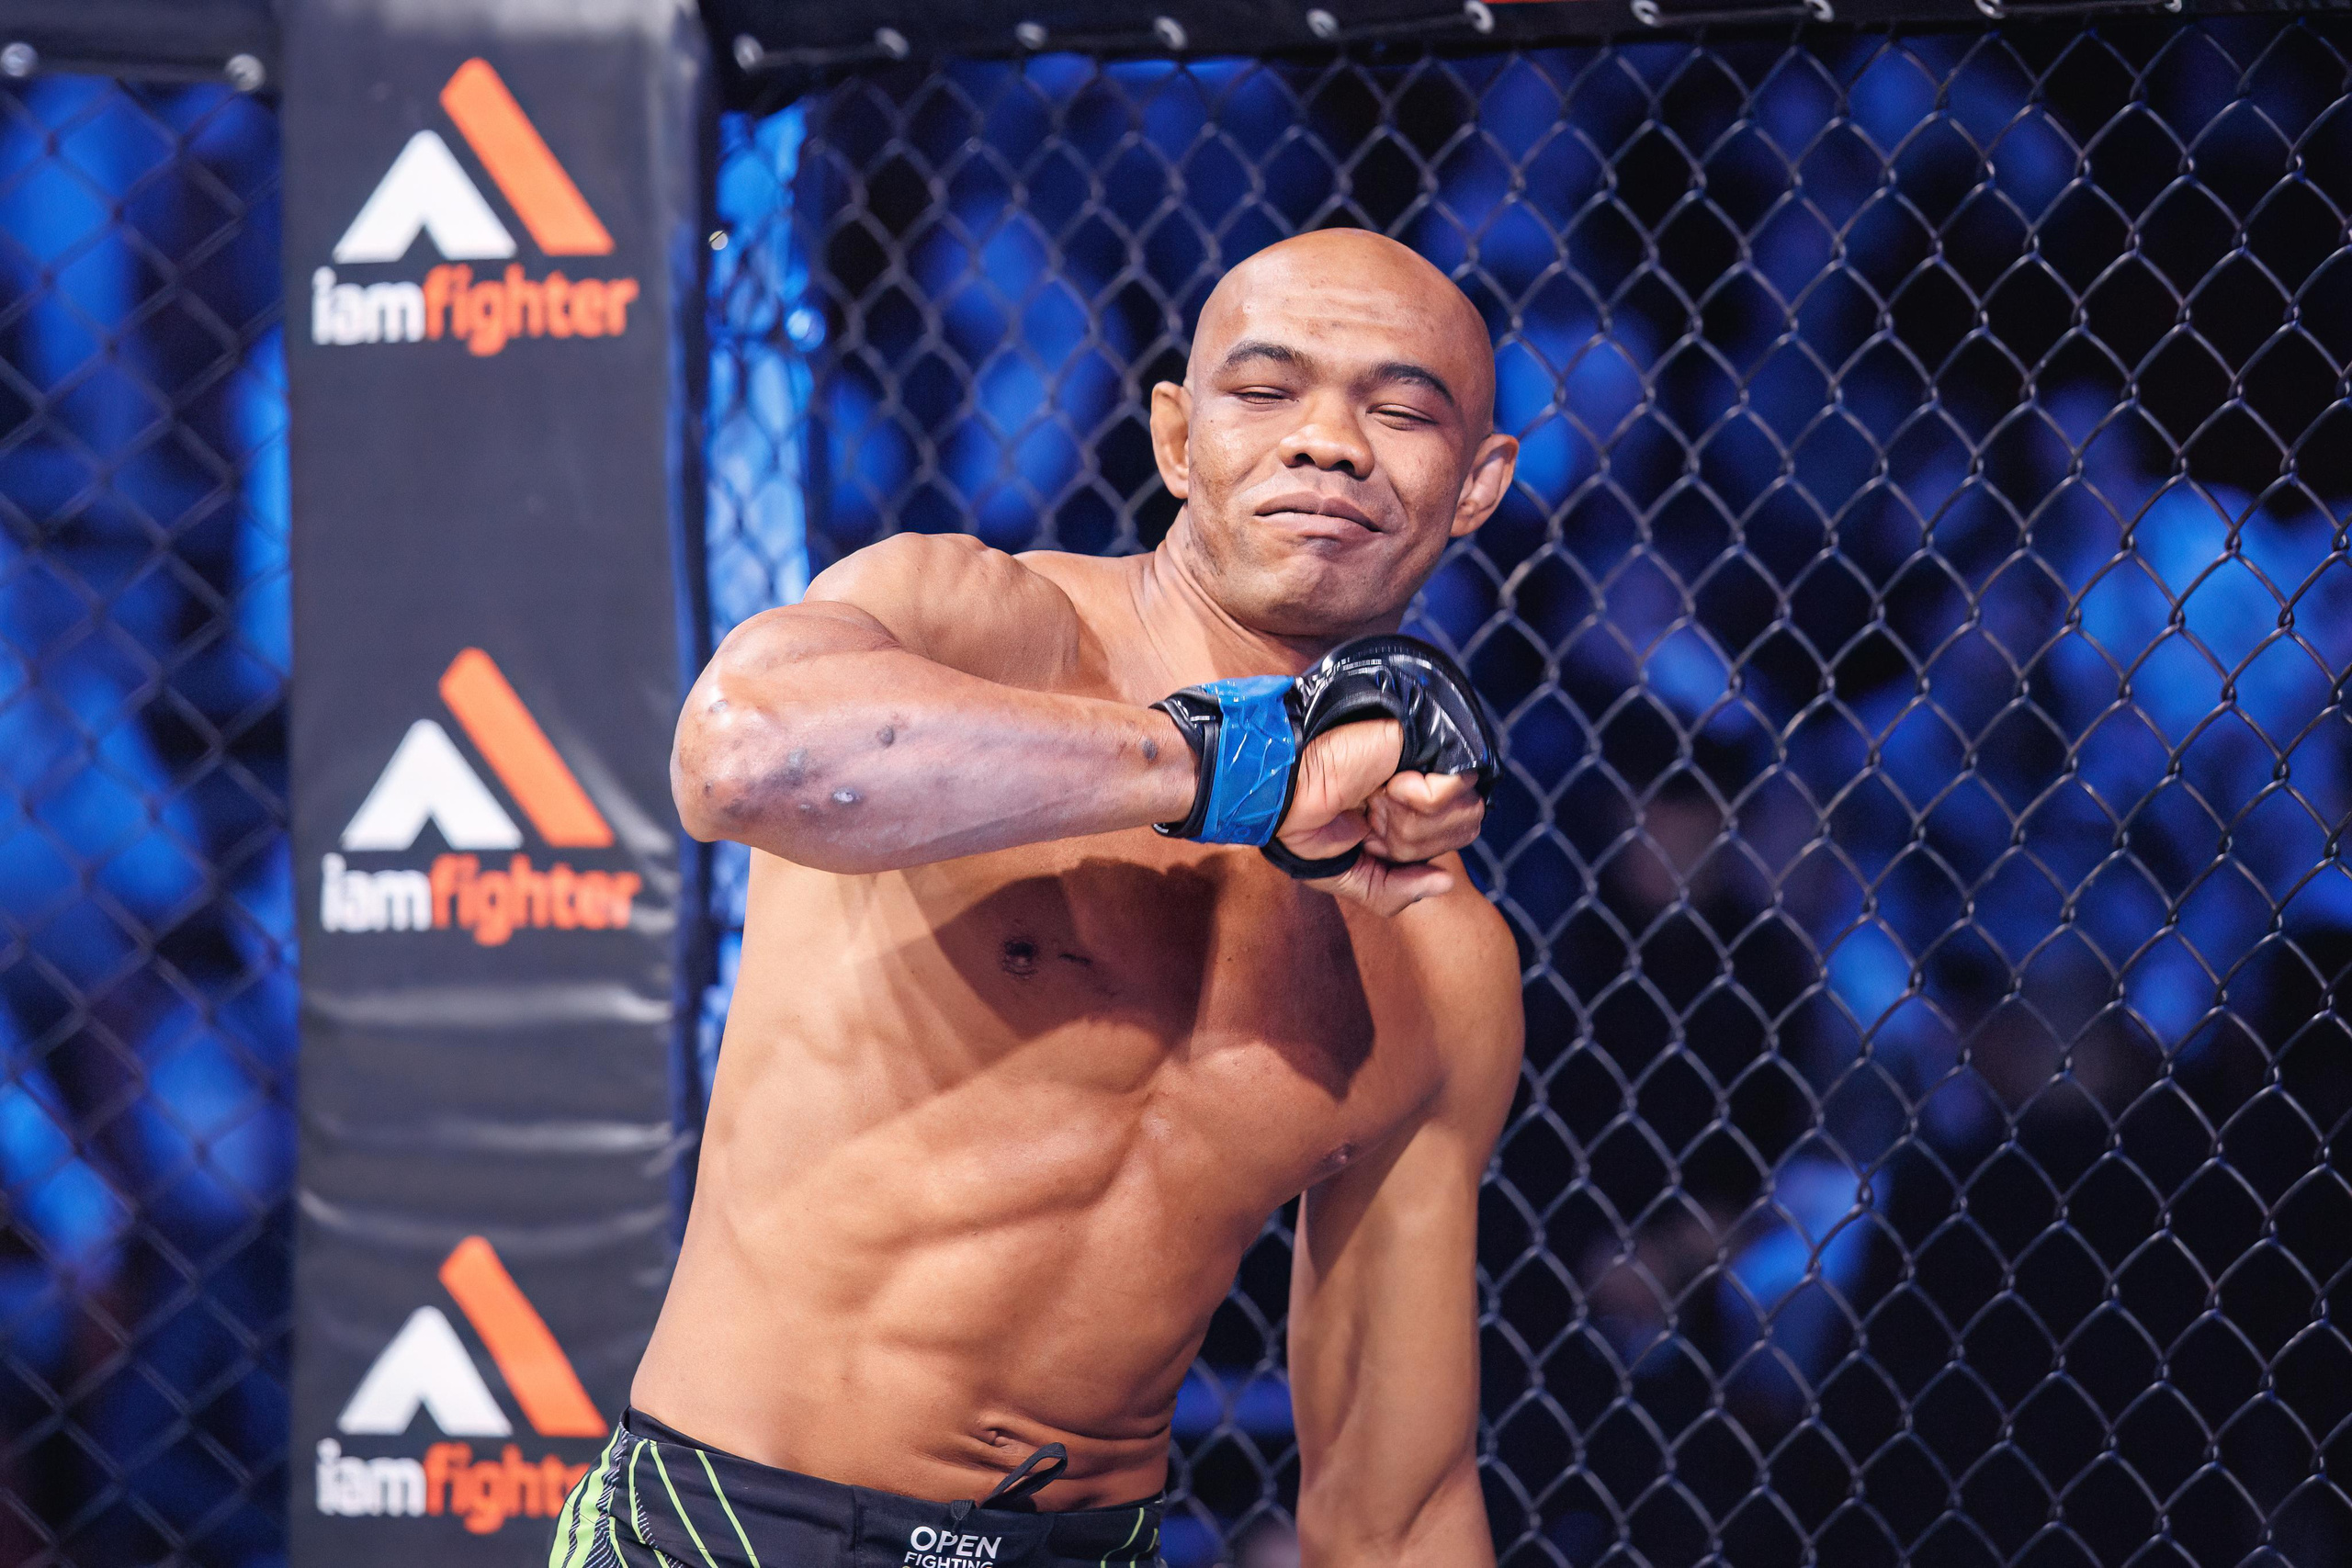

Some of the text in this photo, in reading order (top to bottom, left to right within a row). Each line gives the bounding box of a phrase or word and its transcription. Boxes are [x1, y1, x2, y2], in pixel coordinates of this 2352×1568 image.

[312, 264, 639, 355] iamfighter
[322, 852, 640, 946] iamfighter
[316, 1438, 591, 1534] iamfight
[910, 1526, 1001, 1559] OPEN
